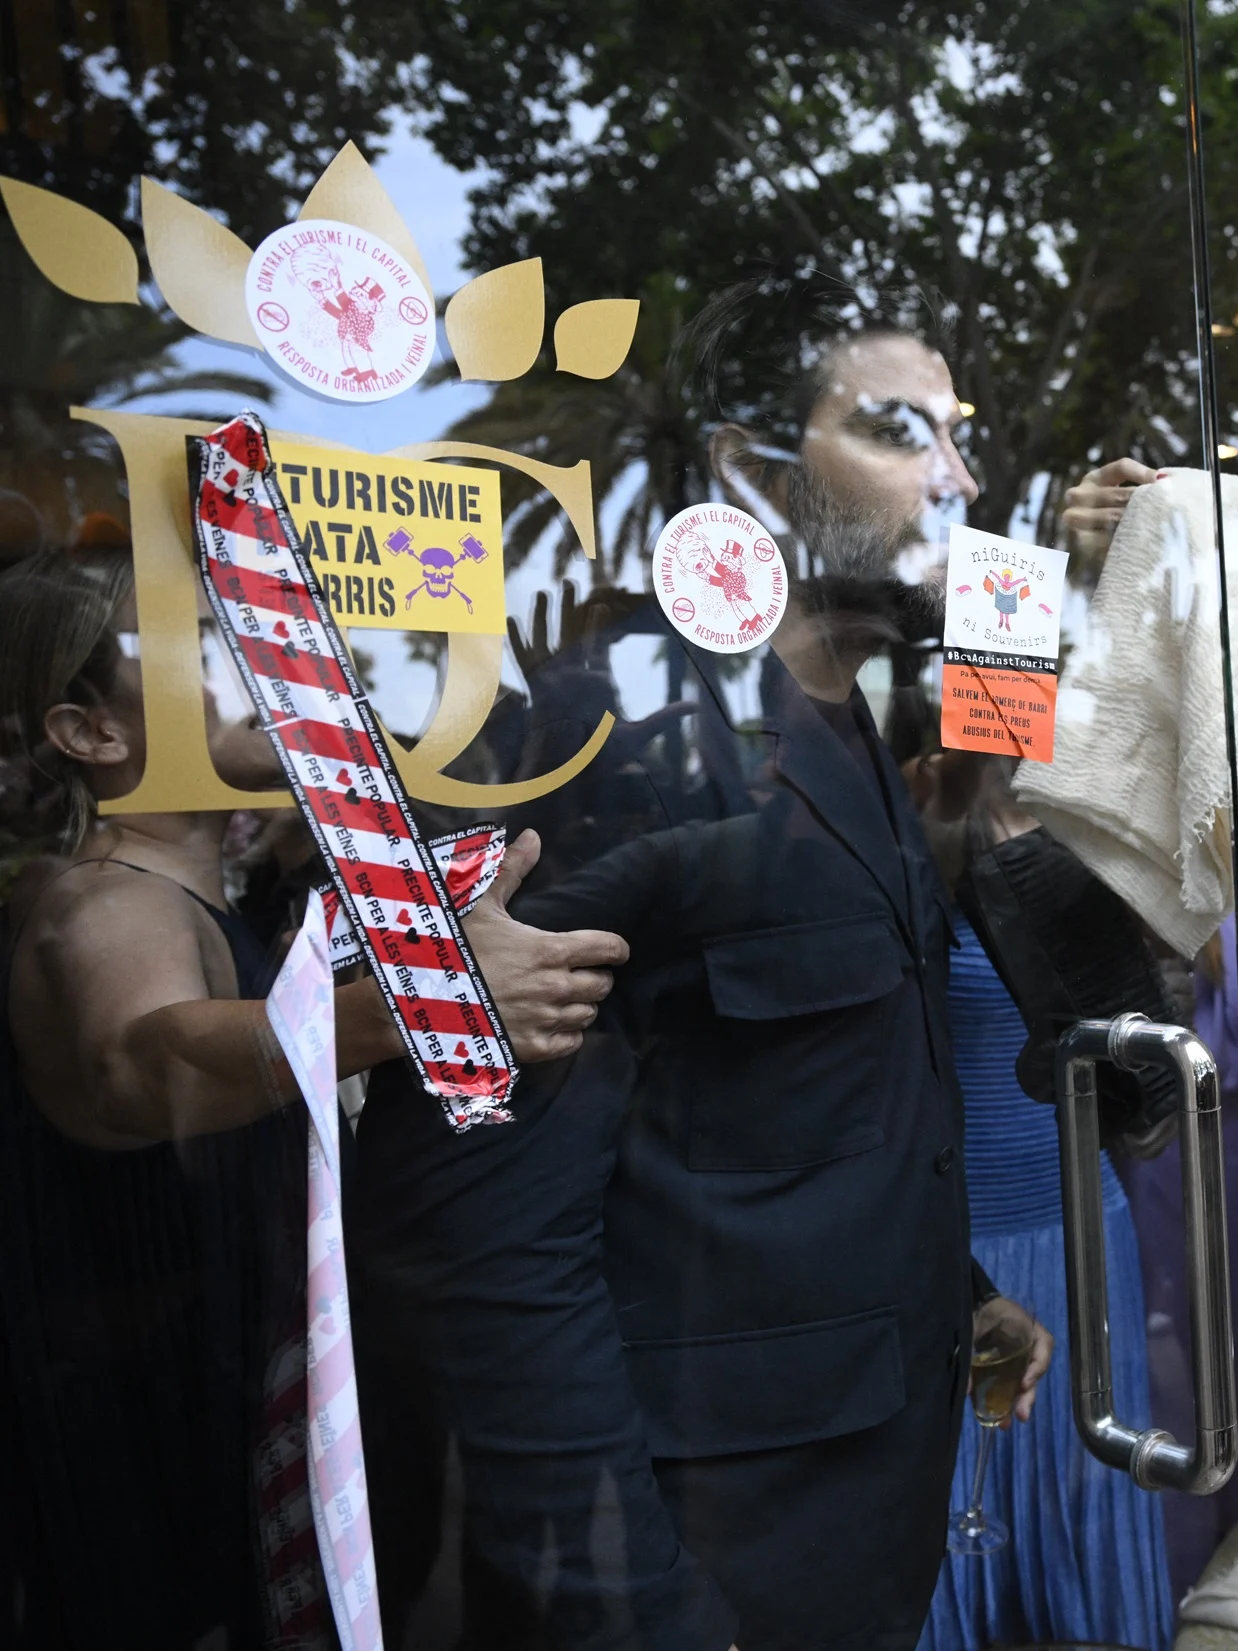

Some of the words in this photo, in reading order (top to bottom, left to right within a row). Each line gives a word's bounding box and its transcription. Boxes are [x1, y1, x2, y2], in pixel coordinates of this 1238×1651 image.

[256, 250, 285, 292] CONTRA
[278, 240, 295, 257] EL
[292, 230, 343, 246] TURISME
[347, 234, 351, 246] I
[356, 238, 368, 254] EL
[371, 248, 412, 288] CAPITAL
[277, 340, 330, 385] RESPOSTA
[334, 368, 407, 393] ORGANITZADA
[401, 363, 412, 374] I
[281, 462, 482, 524] TURISME
[670, 513, 703, 542] TURISME
[703, 512, 708, 522] I
[709, 510, 720, 522] EL
[722, 511, 755, 536] CAPITAL
[300, 519, 382, 566] ATA
[664, 542, 677, 554] EL
[661, 557, 675, 593] CONTRA
[971, 547, 1045, 581] niGuiris
[242, 487, 279, 556] POPULAR
[273, 568, 313, 637] PRECINTE
[303, 637, 341, 703] POPULAR
[321, 573, 396, 618] RRIS
[238, 606, 261, 634] PER
[694, 624, 736, 645] RESPOSTA
[737, 602, 780, 644] ORGANITZADA
[962, 617, 977, 632] ni
[984, 628, 1047, 647] Souvenirs
[325, 627, 341, 659] CONTRA
[338, 658, 346, 666] EL
[342, 666, 361, 697] CAPITAL
[947, 651, 1056, 670] #BcnAgainstTourism
[952, 688, 979, 701] SALVEM
[1018, 700, 1027, 710] DE
[1028, 702, 1048, 714] BARRI
[358, 704, 375, 734] CONTRA
[969, 708, 995, 721] CONTRA
[1010, 715, 1031, 728] PREUS
[370, 732, 378, 741] EL
[962, 725, 991, 738] ABUSIUS
[993, 729, 1005, 741] DEL
[269, 731, 293, 773] DEFENSEM
[374, 742, 390, 772] CAPITAL
[288, 771, 299, 783] LA
[304, 756, 326, 784] PER
[293, 783, 306, 802] VIDA
[315, 785, 329, 795] A
[387, 775, 404, 802] CONTRA
[320, 794, 341, 821] LES
[399, 802, 408, 812] EL
[301, 804, 325, 846] DEFENSEM
[403, 812, 420, 840] CAPITAL
[428, 833, 457, 847] CONTRA
[456, 831, 466, 839] EL
[466, 824, 497, 835] CAPITAL
[319, 845, 330, 857] LA
[332, 819, 360, 866] VEÏNES
[324, 856, 337, 873] VIDA
[417, 843, 433, 872] CONTRA
[337, 717, 375, 785] PRECINTE
[365, 784, 401, 847] POPULAR
[397, 858, 434, 923] PRECINTE
[425, 922, 459, 983] POPULAR
[455, 992, 490, 1053] PRECINTE
[355, 872, 376, 900] BCN
[428, 871, 437, 881] EL
[333, 875, 357, 916] DEFENSEM
[432, 880, 450, 908] CAPITAL
[350, 914, 360, 926] LA
[367, 899, 387, 926] PER
[445, 911, 461, 938] CONTRA
[356, 925, 369, 942] VIDA
[376, 926, 390, 937] A
[455, 937, 464, 947] EL
[380, 934, 400, 960] LES
[460, 946, 476, 974] CAPITAL
[345, 955, 357, 967] LA
[364, 945, 386, 986] DEFENSEM
[380, 985, 391, 996] LA
[393, 957, 420, 1004] VEÏNES
[473, 976, 488, 1003] CONTRA
[385, 994, 397, 1012] VIDA
[483, 1002, 491, 1011] EL
[393, 1012, 415, 1052] DEFENSEM
[413, 1008, 434, 1035] BCN
[487, 1011, 504, 1038] CAPITAL
[409, 1051, 419, 1062] LA
[425, 1033, 444, 1060] PER
[499, 1040, 515, 1066] CONTRA
[415, 1059, 427, 1076] VIDA
[436, 1059, 448, 1070] A
